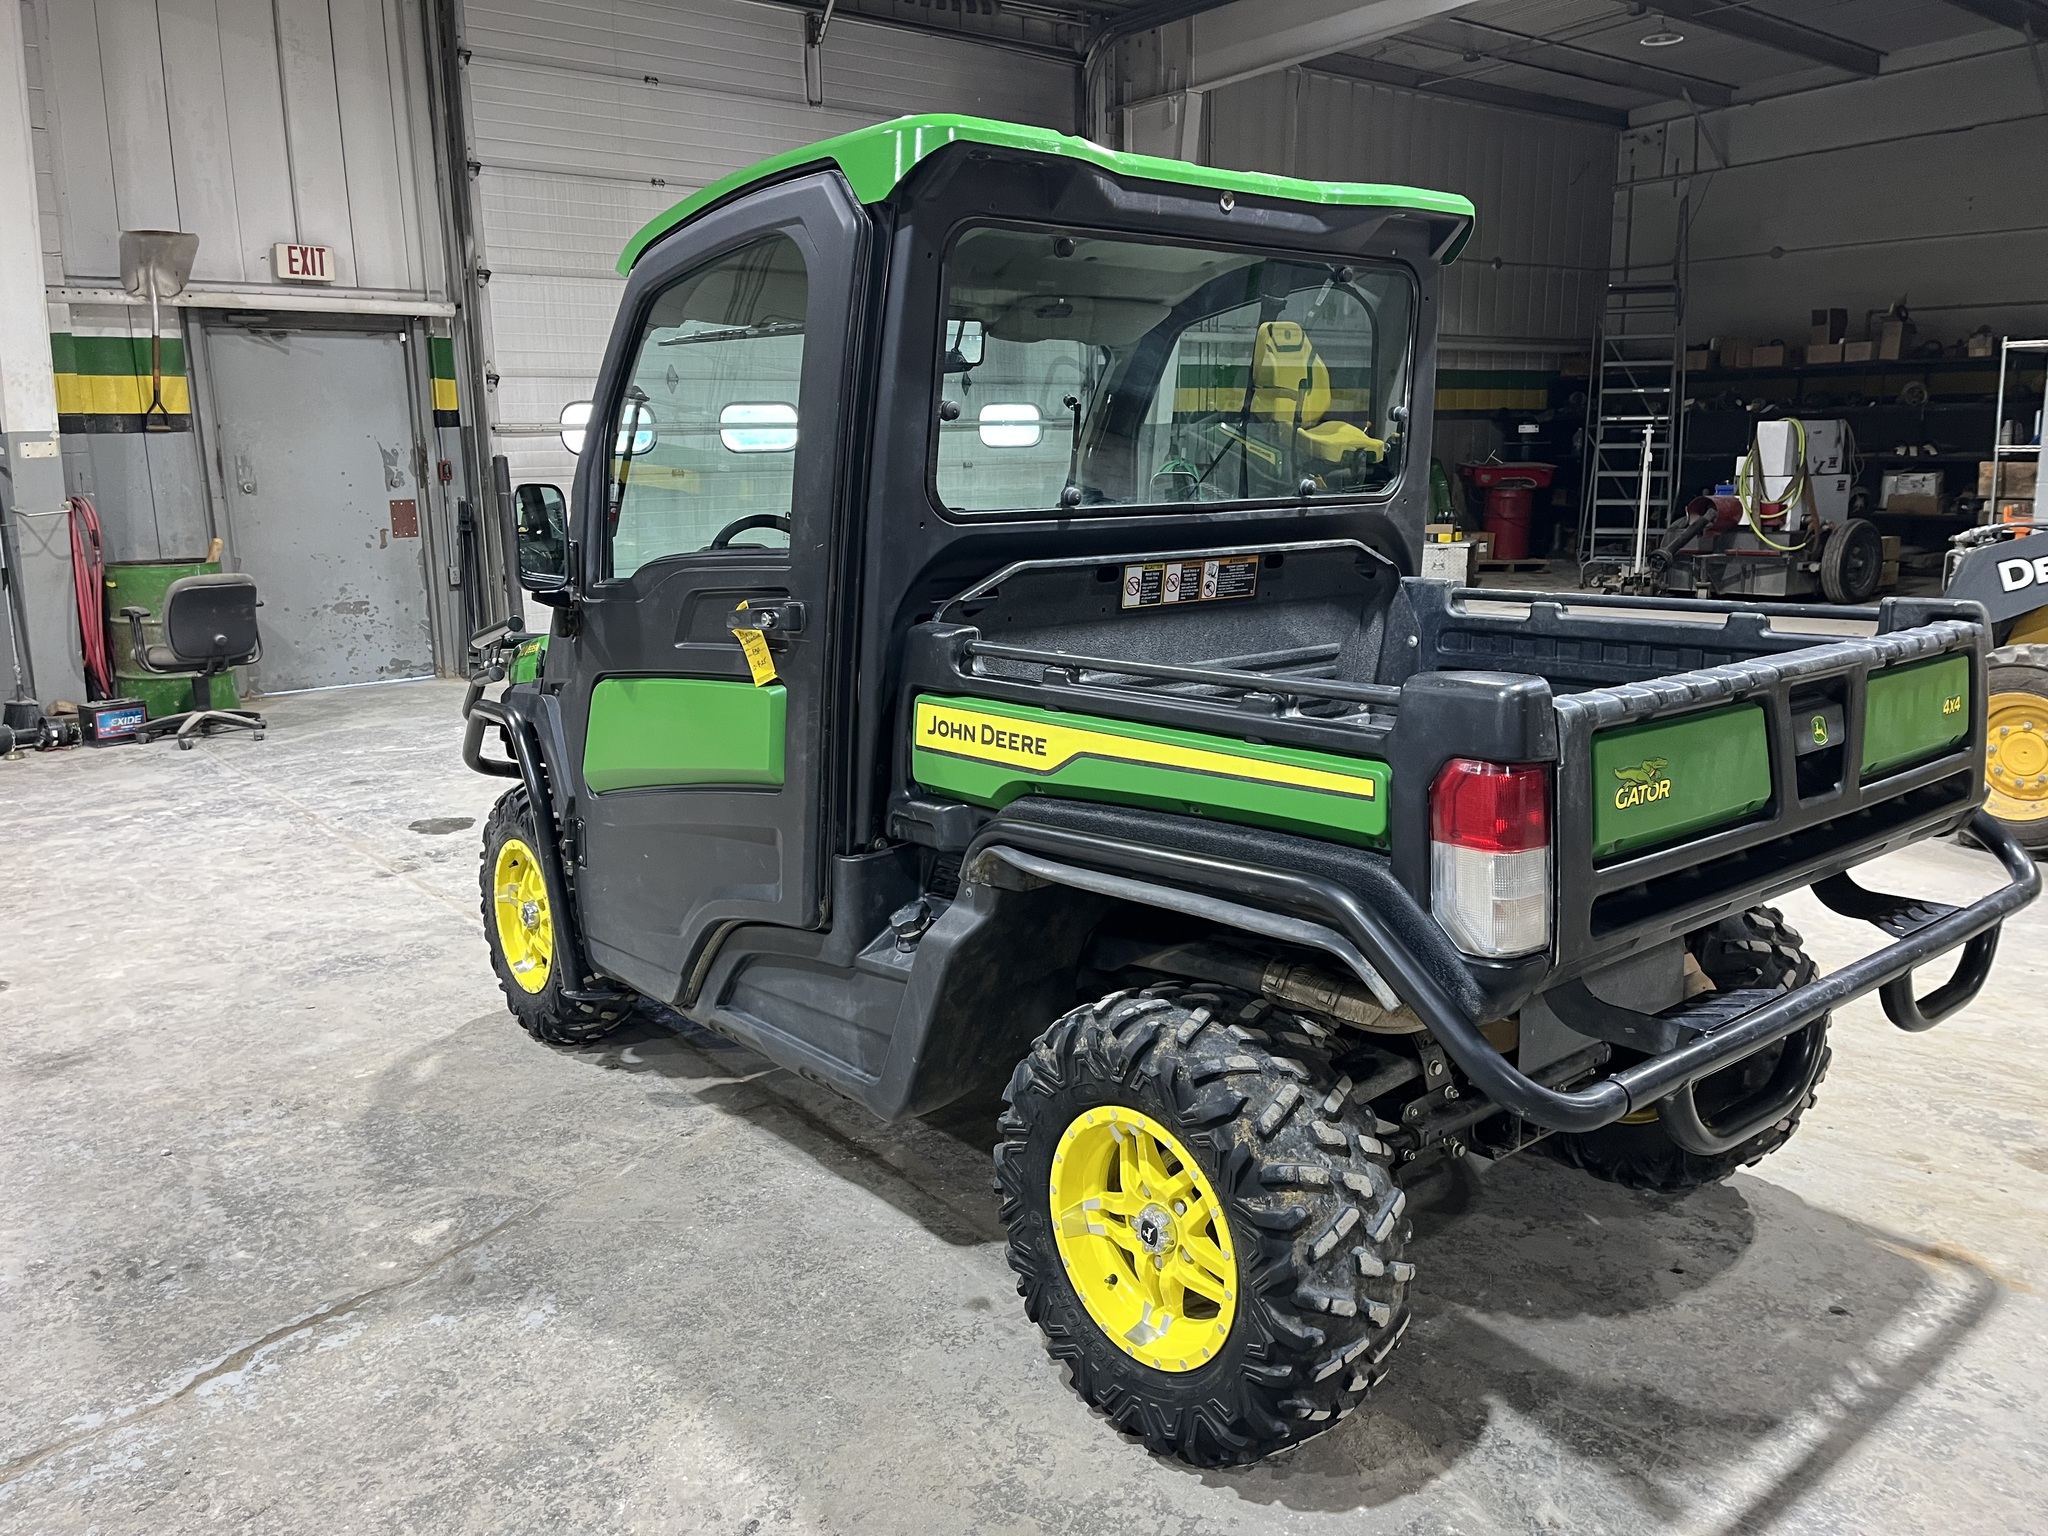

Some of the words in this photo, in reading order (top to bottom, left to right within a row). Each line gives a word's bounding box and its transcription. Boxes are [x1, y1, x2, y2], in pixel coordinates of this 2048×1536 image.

[287, 245, 326, 277] EXIT
[110, 715, 142, 726] EXIDE
[927, 715, 976, 743] JOHN
[981, 723, 1047, 757] DEERE
[1615, 778, 1671, 810] GATOR
